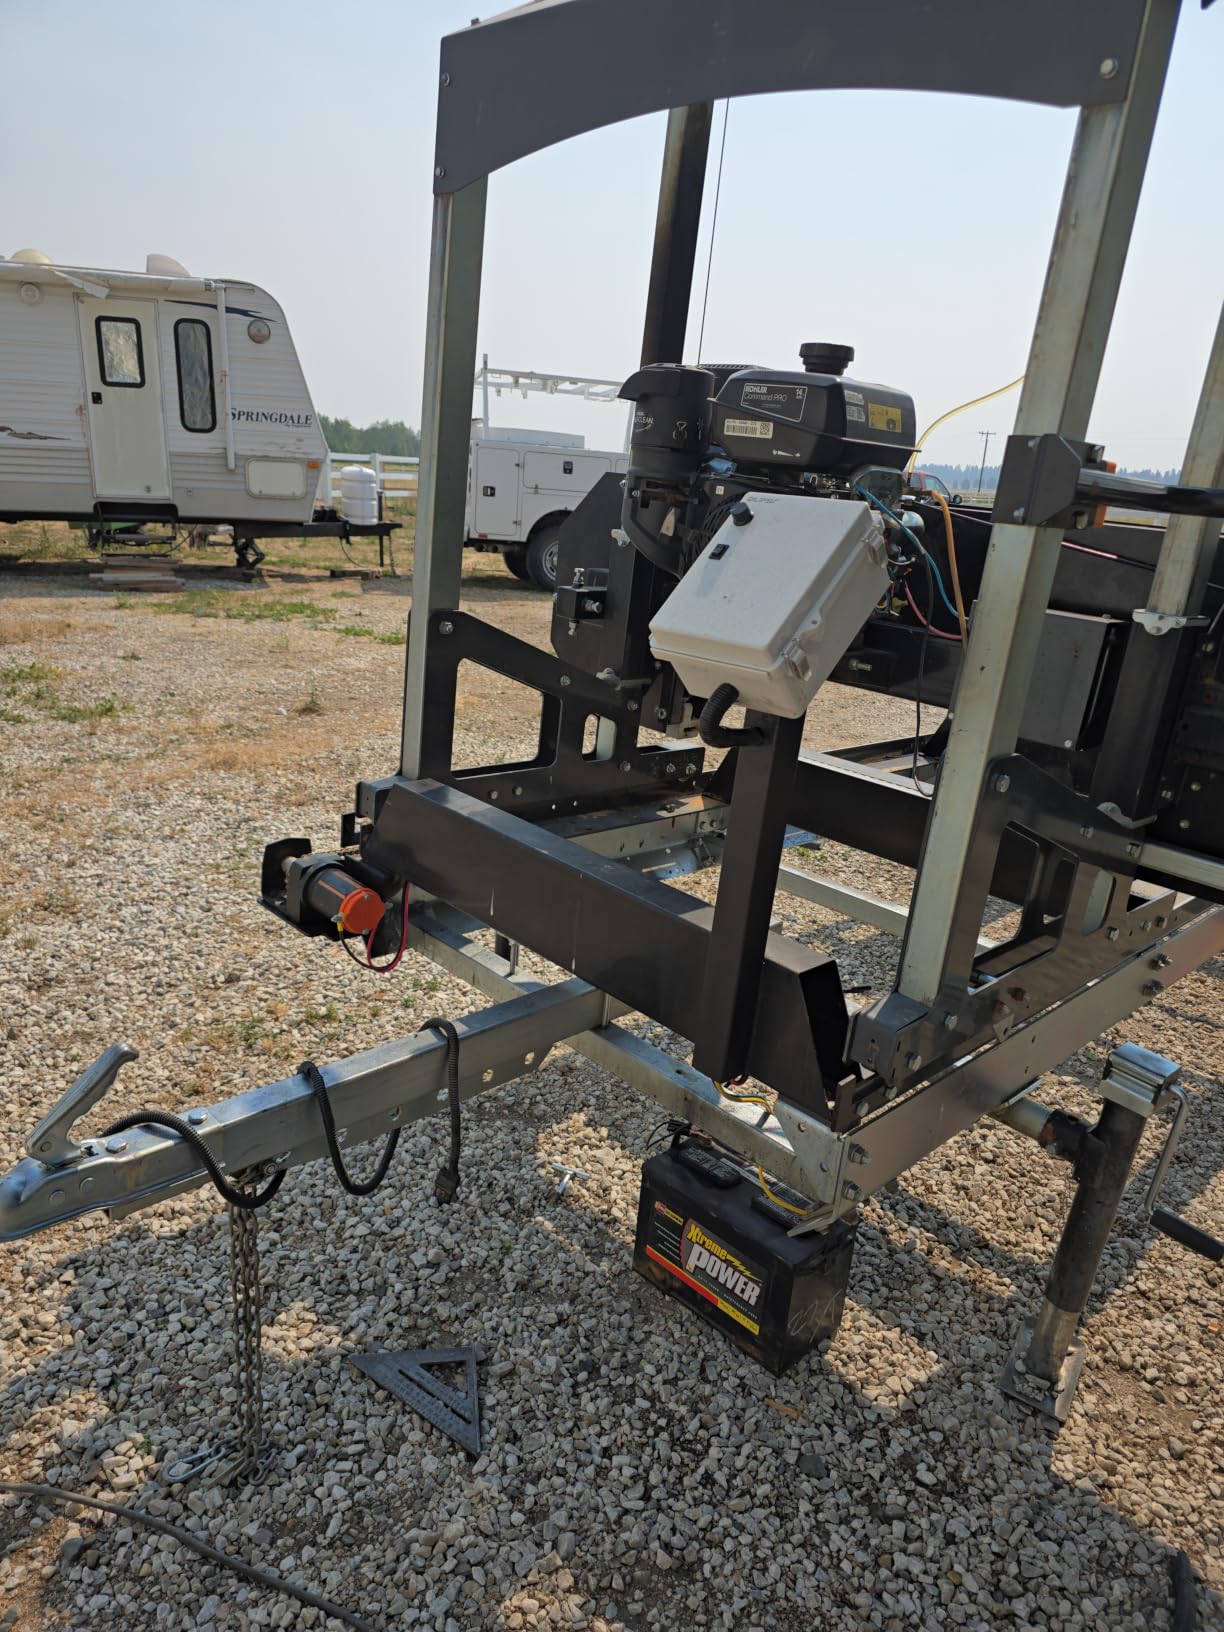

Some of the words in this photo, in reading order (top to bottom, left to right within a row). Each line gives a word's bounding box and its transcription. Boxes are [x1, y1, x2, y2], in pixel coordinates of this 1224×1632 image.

[743, 392, 773, 401] Command
[773, 393, 788, 402] PRO
[231, 407, 313, 425] SPRINGDALE
[686, 1223, 728, 1260] Xtreme
[685, 1242, 761, 1307] POWER
